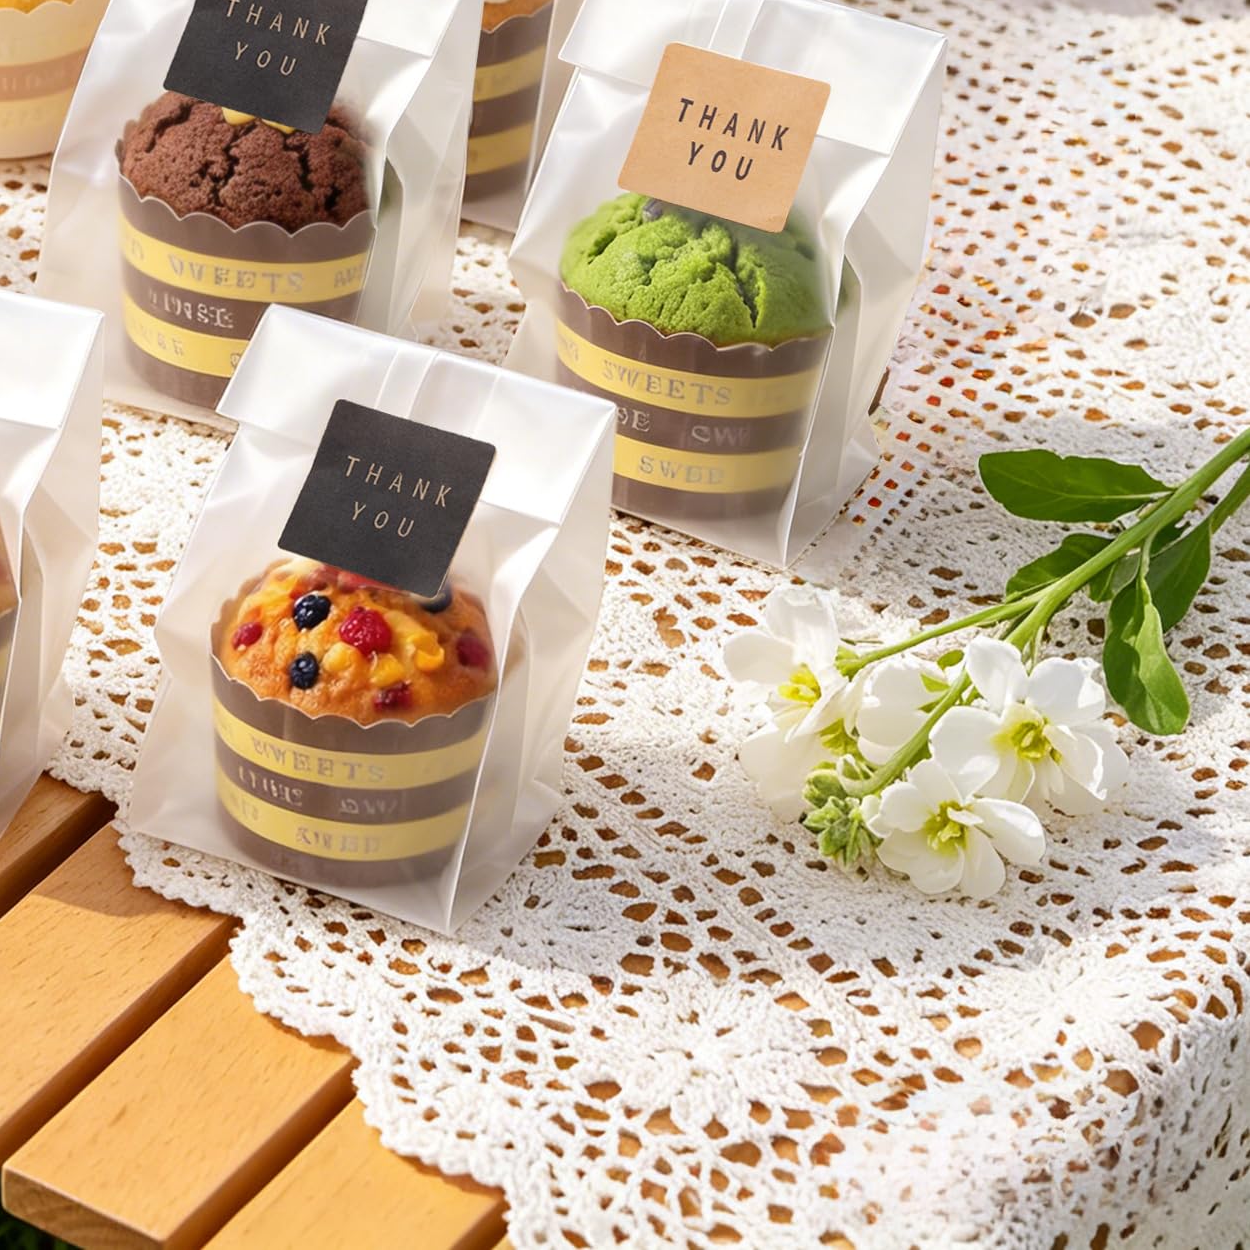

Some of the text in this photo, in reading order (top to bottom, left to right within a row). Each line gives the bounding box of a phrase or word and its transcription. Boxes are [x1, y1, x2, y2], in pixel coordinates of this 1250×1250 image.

[235, 41, 297, 76] YOU
[678, 97, 790, 151] THANK
[687, 140, 754, 181] YOU
[602, 359, 731, 406] SWEETS
[345, 455, 452, 508] THANK
[352, 501, 415, 538] YOU
